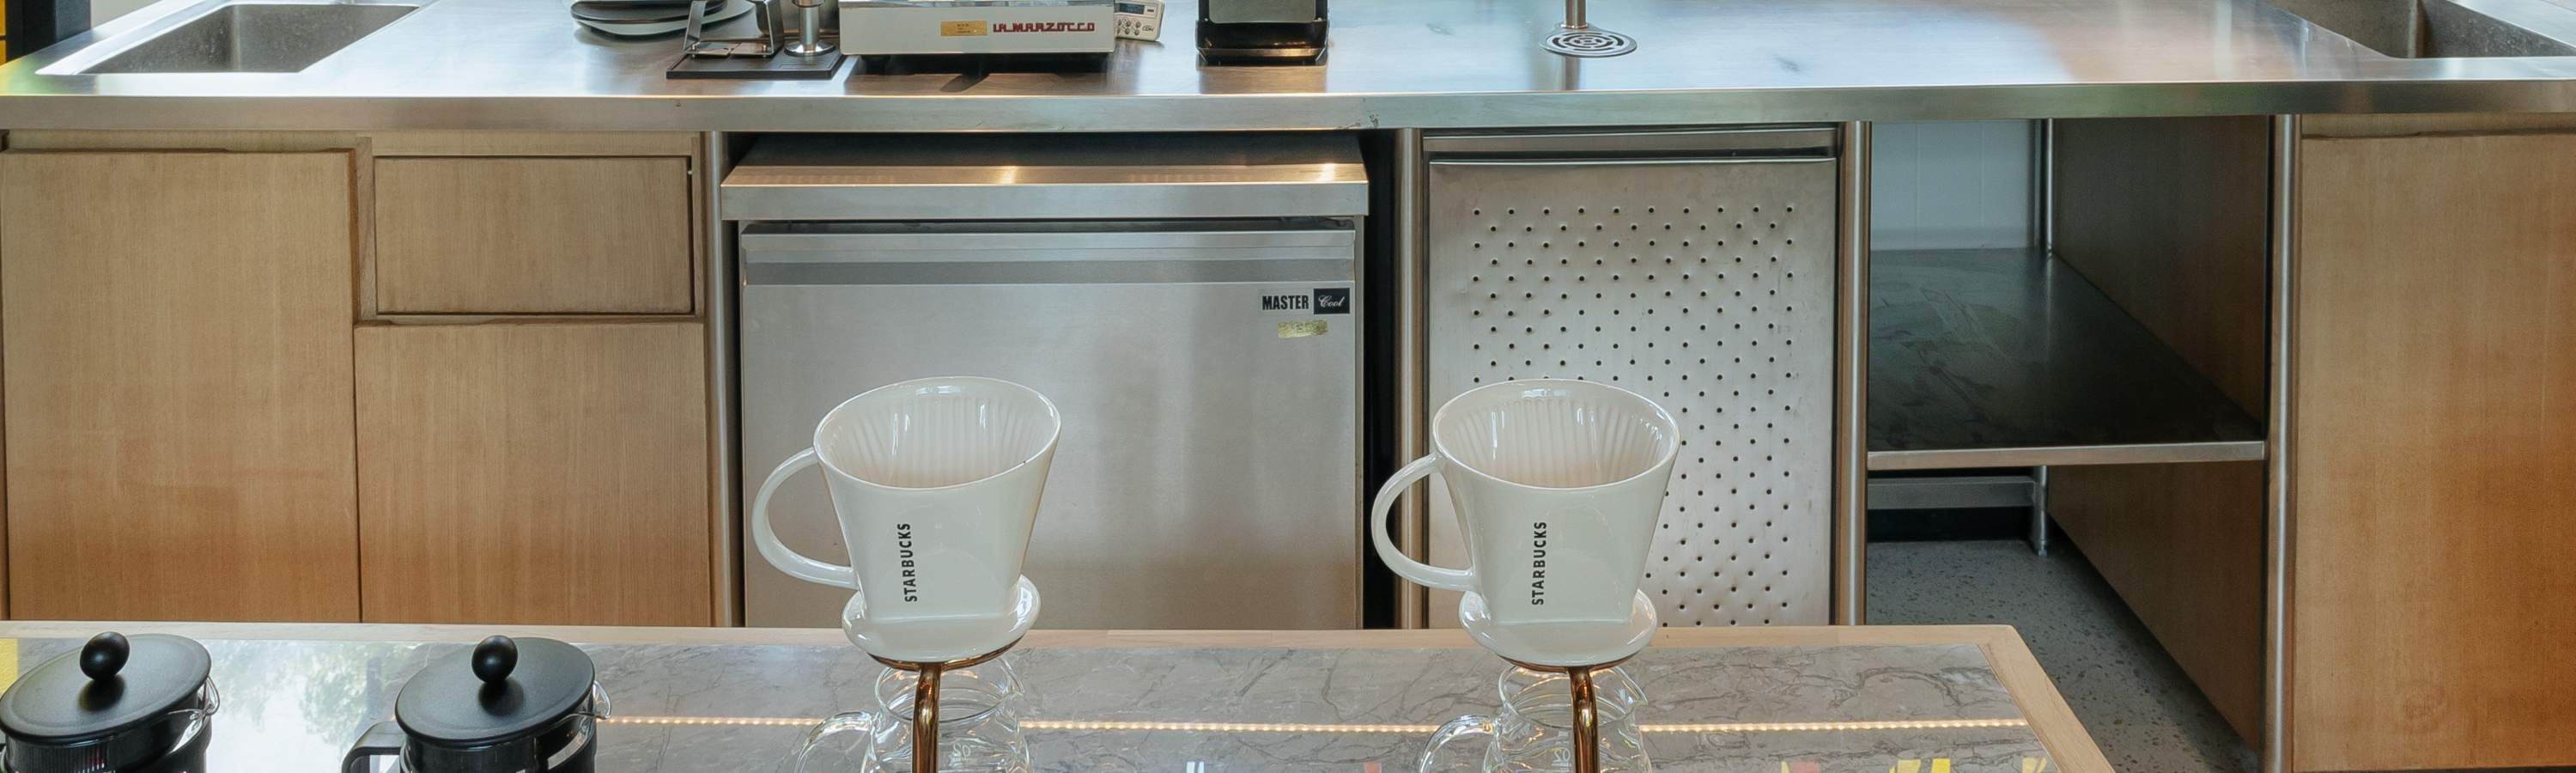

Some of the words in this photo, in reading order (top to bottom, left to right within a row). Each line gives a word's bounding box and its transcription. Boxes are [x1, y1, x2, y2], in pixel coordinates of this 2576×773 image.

[1012, 21, 1095, 33] MARZOCCO
[1262, 295, 1309, 310] MASTER
[1318, 295, 1346, 308] Cool
[897, 523, 918, 603] STARBUCKS
[1531, 521, 1547, 606] STARBUCKS
